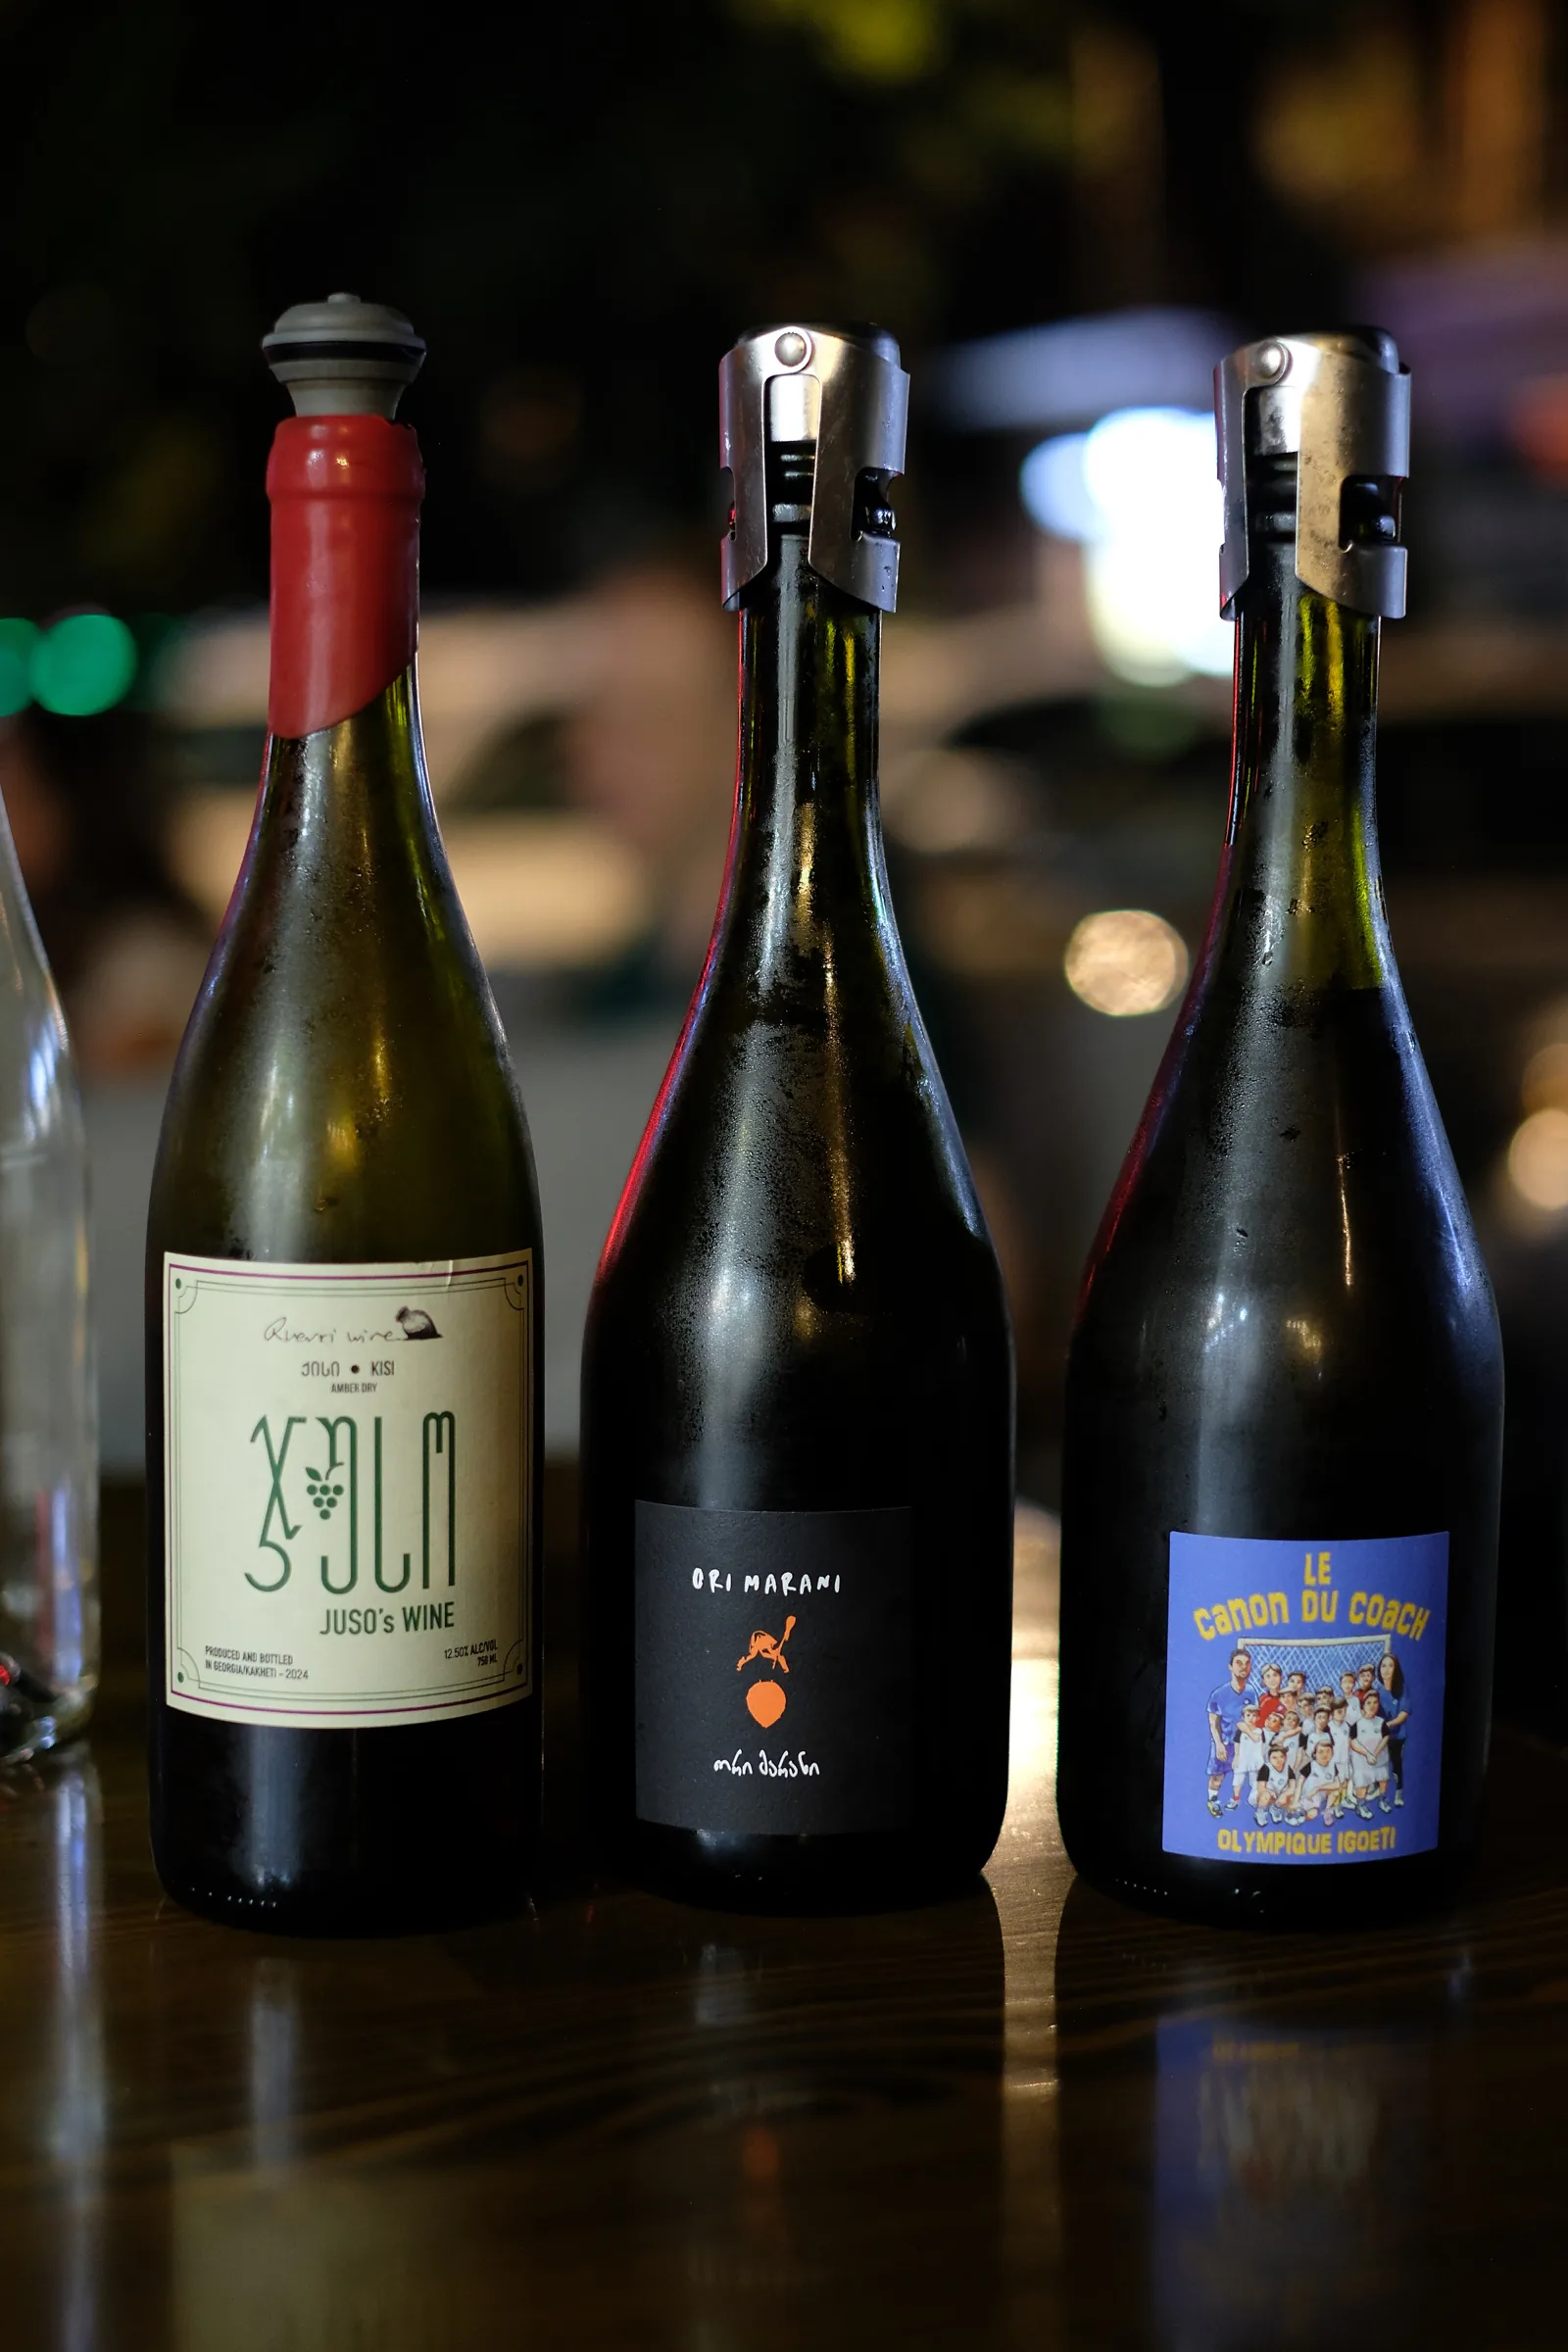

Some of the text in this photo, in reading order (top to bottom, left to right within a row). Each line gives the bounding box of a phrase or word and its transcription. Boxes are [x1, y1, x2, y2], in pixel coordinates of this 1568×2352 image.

[371, 1360, 395, 1376] KISI
[331, 1383, 378, 1394] AMBER DRY
[1303, 1551, 1332, 1586] LE
[692, 1568, 841, 1596] ORI MARANI
[319, 1601, 455, 1635] JUSO's WINE
[1300, 1589, 1340, 1623] DU
[205, 1645, 293, 1665] PRODUCED AND BOTTLED
[444, 1640, 498, 1659] 12.50% ALC/VOL
[477, 1655, 488, 1667] 750
[205, 1659, 213, 1670] IN
[214, 1661, 277, 1678] GEORGIA/KAKHETI
[285, 1668, 309, 1680] 2024
[713, 1748, 754, 1777] ორი
[1217, 1826, 1396, 1855] OLYMPIQUE IGOETI
